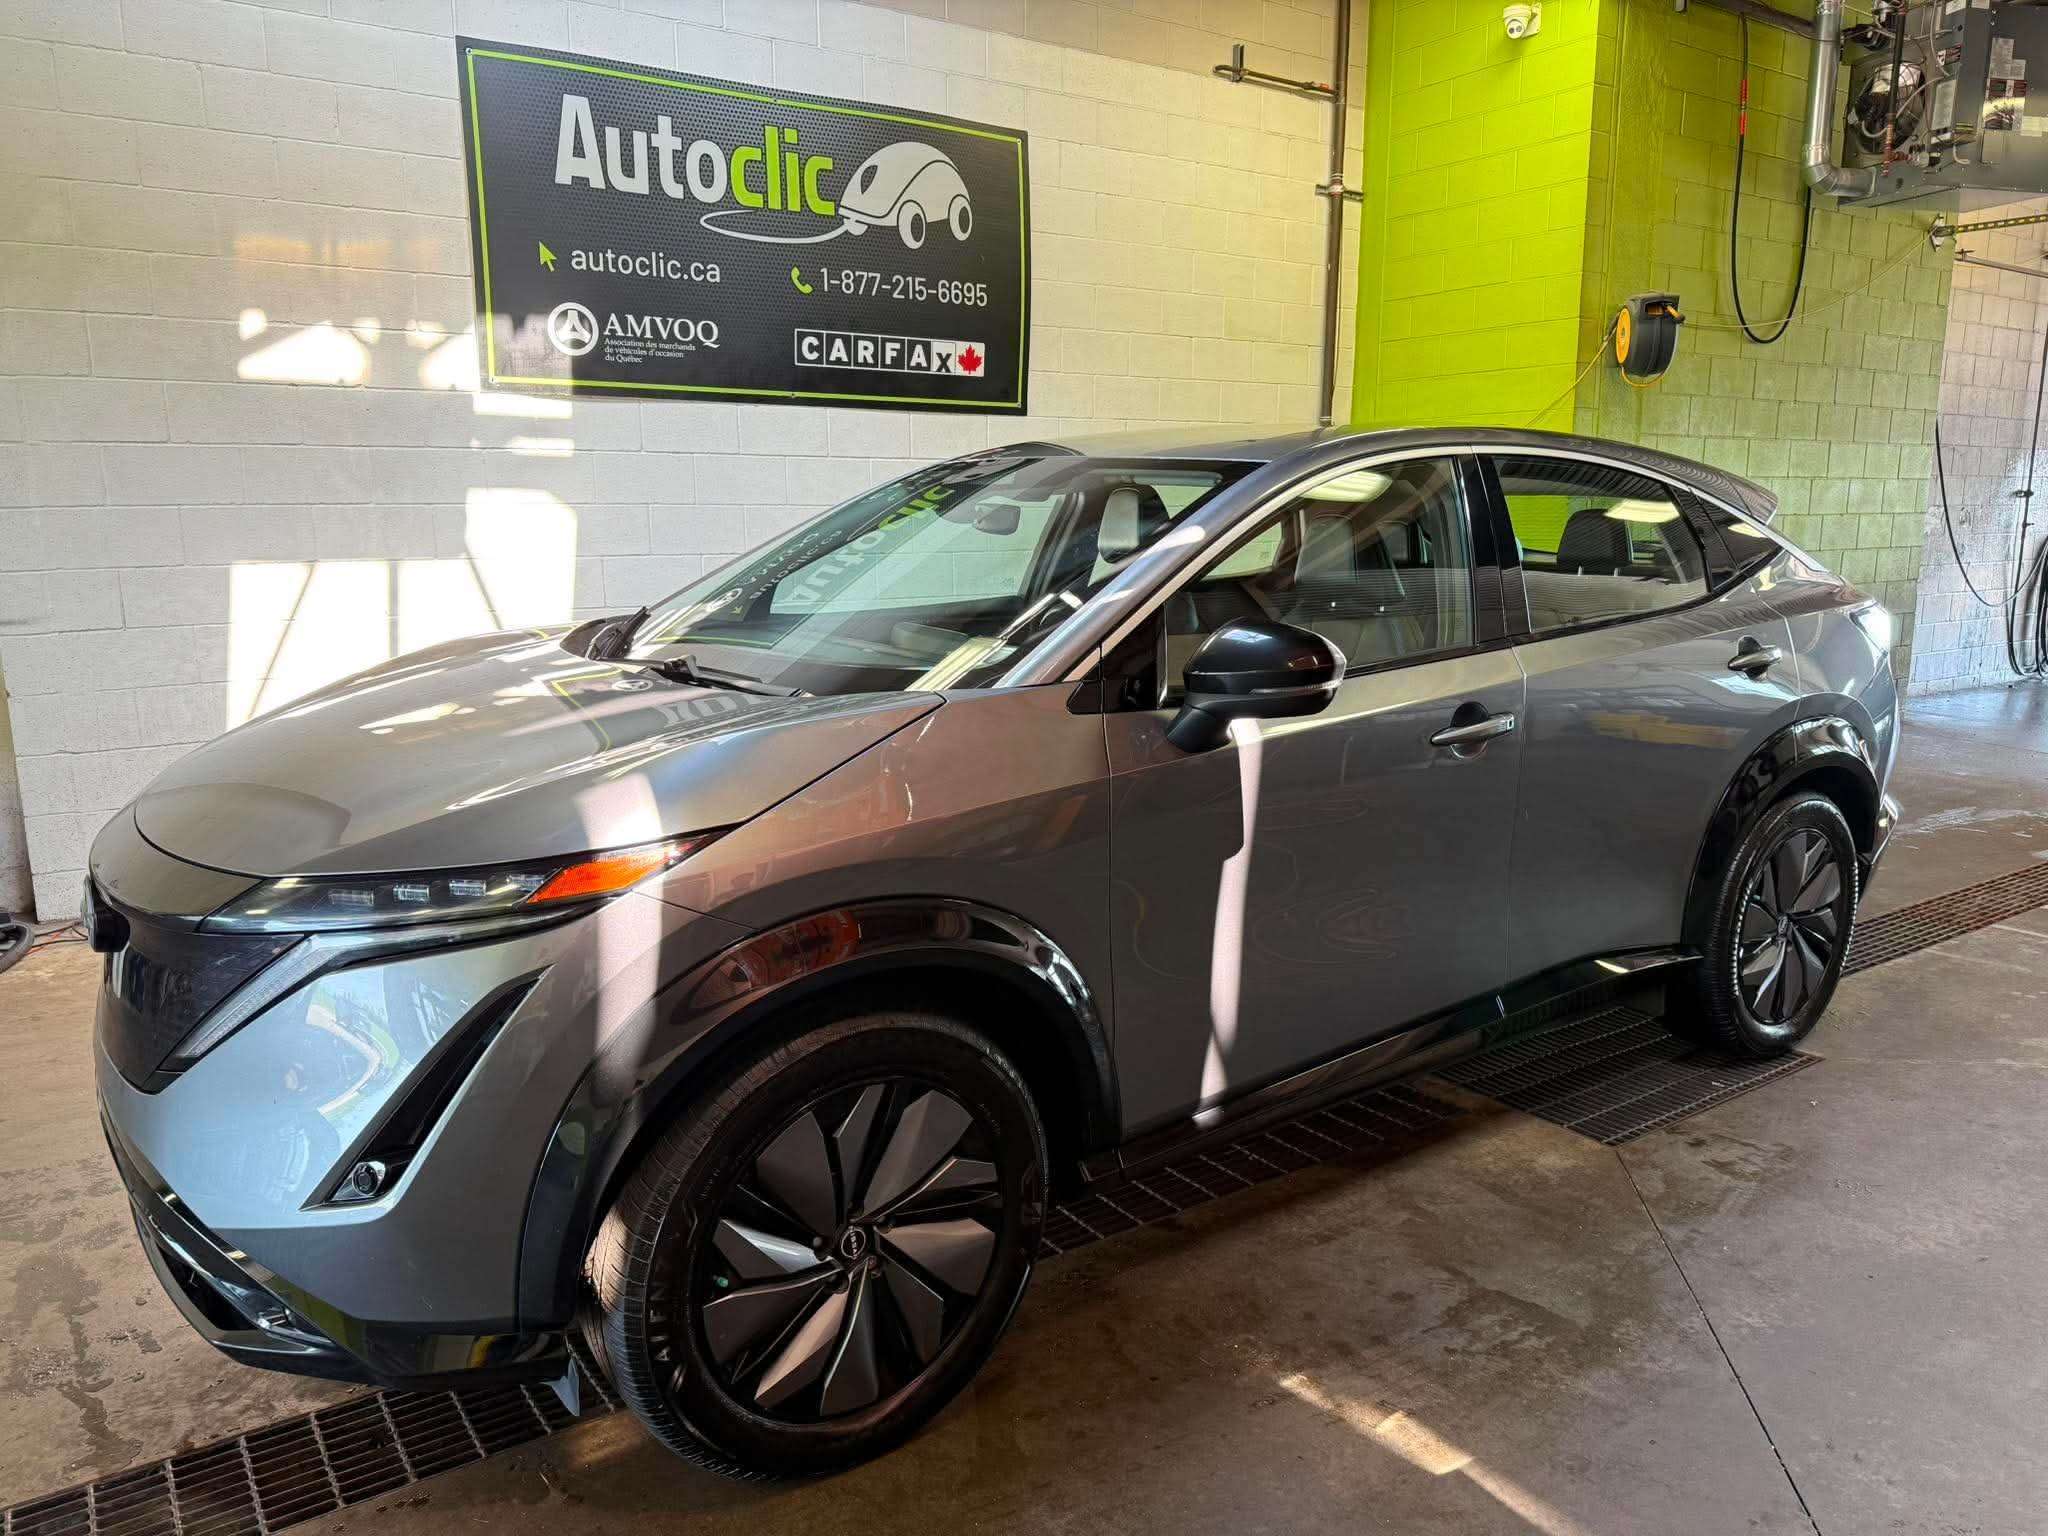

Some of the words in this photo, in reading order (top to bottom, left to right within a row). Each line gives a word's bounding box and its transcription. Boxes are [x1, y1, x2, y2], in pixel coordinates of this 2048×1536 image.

[555, 93, 836, 217] Autoclic
[570, 248, 722, 284] autoclic.ca
[819, 267, 988, 308] 1-877-215-6695
[603, 312, 721, 349] AMVOQ
[604, 338, 644, 348] Association
[646, 340, 658, 348] des
[659, 342, 697, 352] marchands
[604, 345, 614, 353] de
[800, 335, 953, 374] CARFAX
